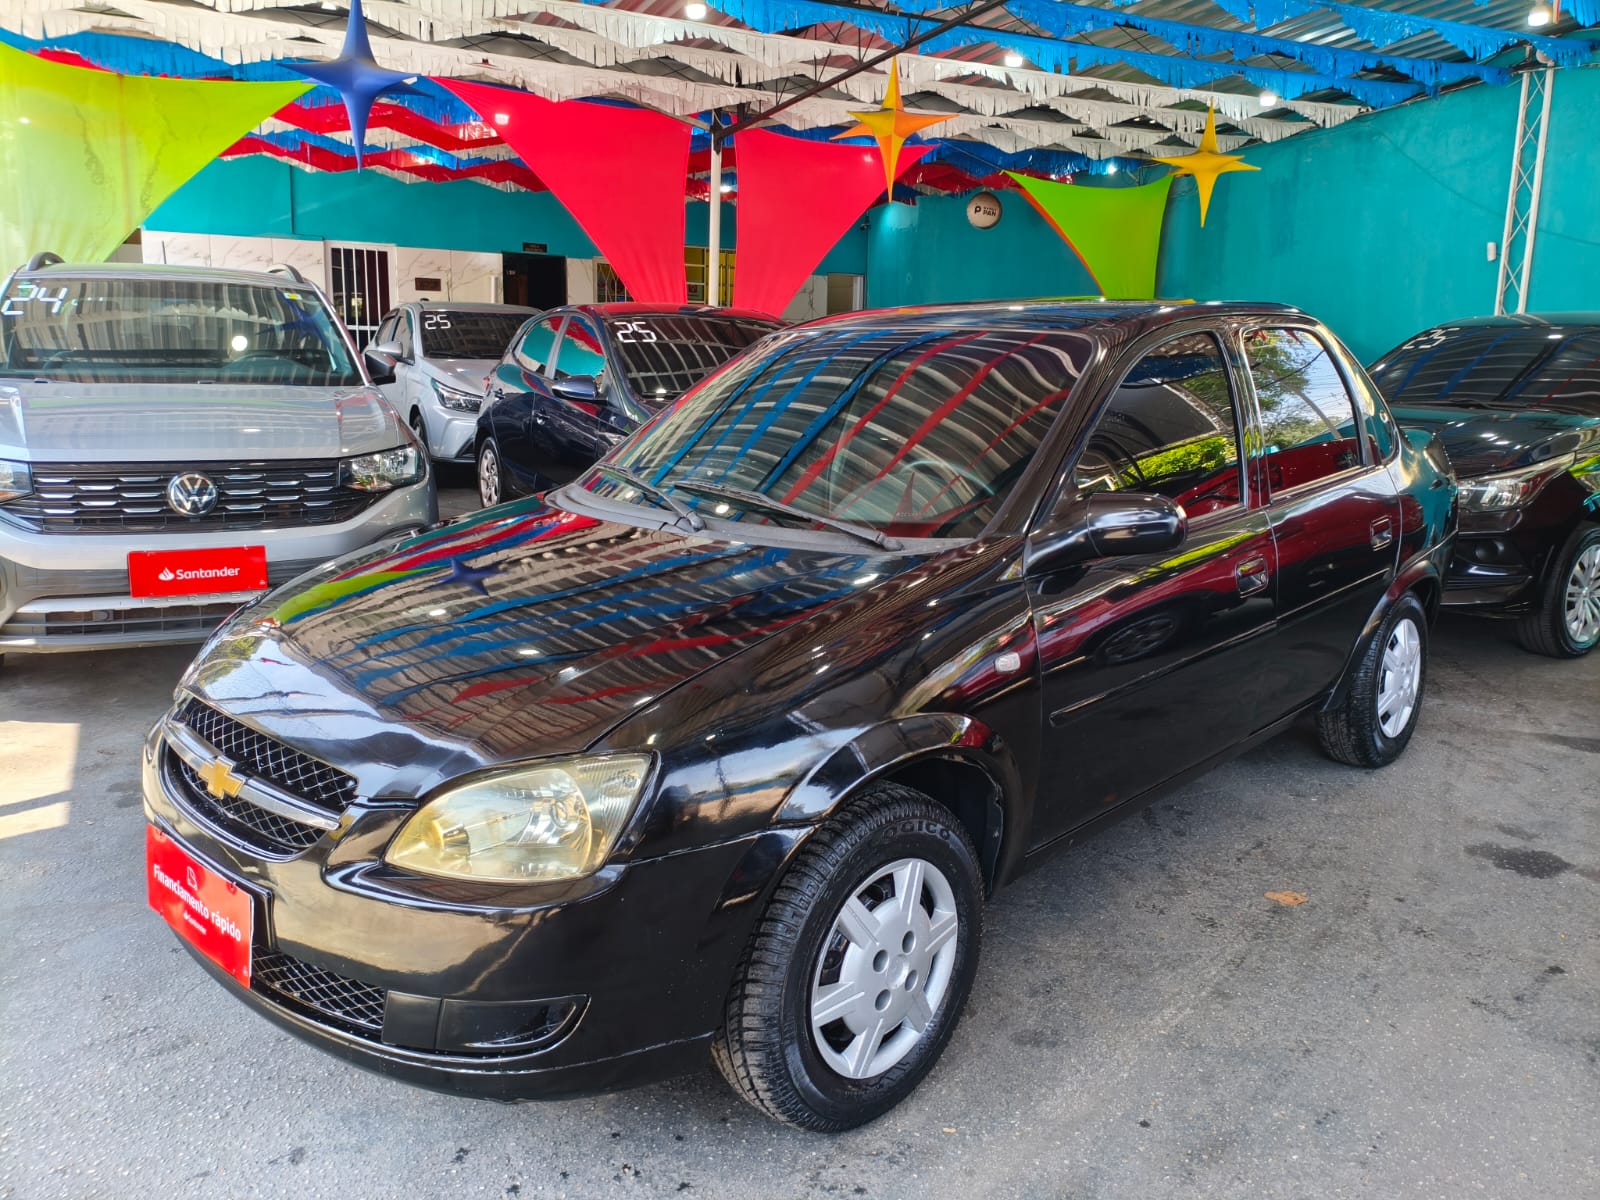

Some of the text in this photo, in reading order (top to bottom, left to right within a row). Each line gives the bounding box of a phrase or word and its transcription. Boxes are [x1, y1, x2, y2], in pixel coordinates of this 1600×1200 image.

[982, 209, 997, 217] PAN
[1, 284, 68, 315] 24
[424, 314, 451, 330] 25
[614, 321, 657, 343] 25
[175, 566, 240, 580] Santander
[153, 863, 241, 942] Financiamento rápido
